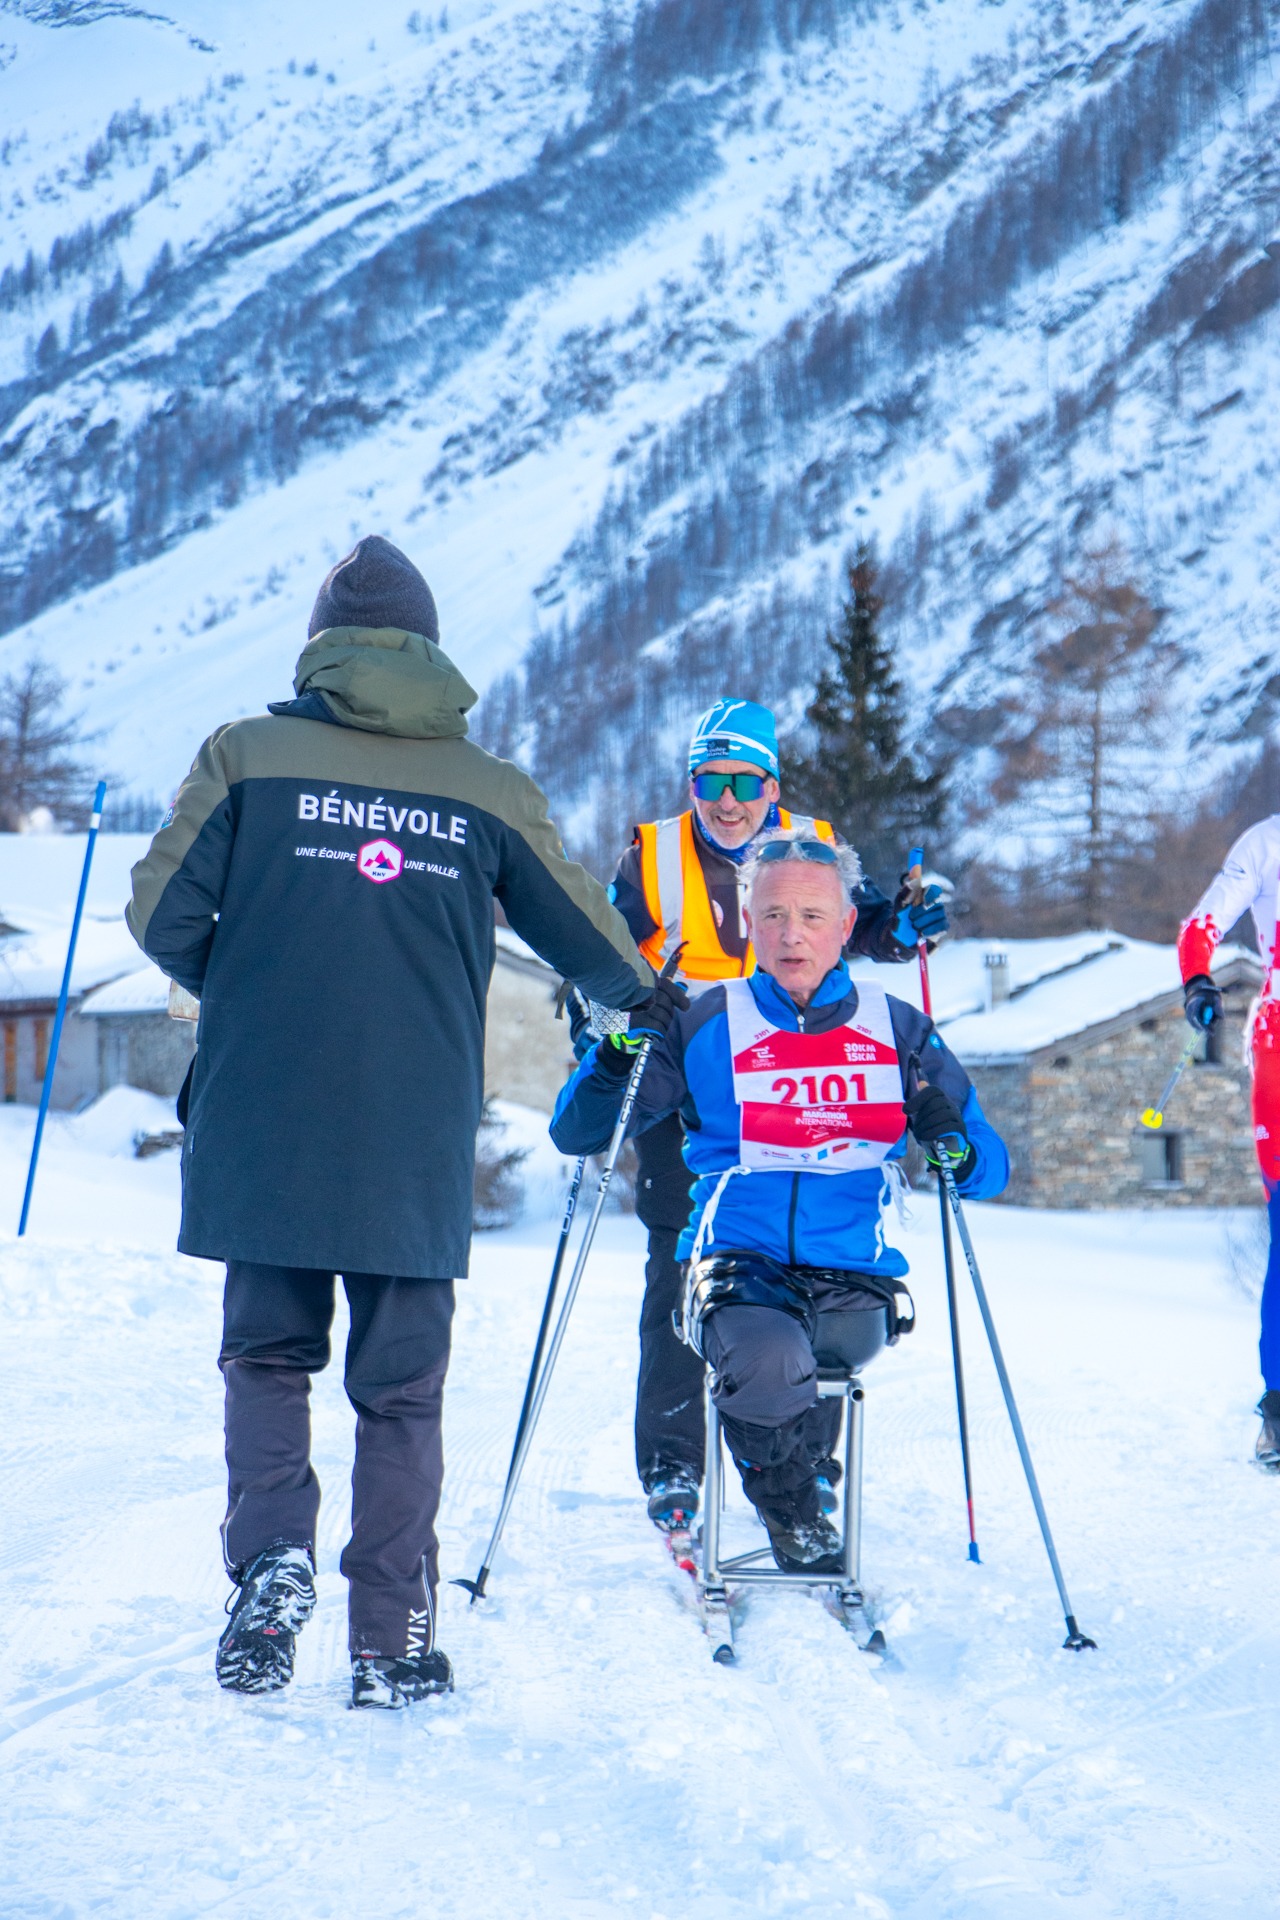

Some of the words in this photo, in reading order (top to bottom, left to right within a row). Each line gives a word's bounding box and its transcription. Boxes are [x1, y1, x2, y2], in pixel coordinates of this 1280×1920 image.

[299, 790, 468, 845] BÉNÉVOLE
[296, 847, 318, 857] UNE
[318, 847, 357, 862] ÉQUIPE
[404, 860, 426, 871] UNE
[427, 863, 460, 879] VALLÉE
[754, 1029, 770, 1041] 2101
[856, 1024, 872, 1035] 2101
[772, 1073, 868, 1105] 2101
[802, 1110, 848, 1121] MARATHON
[795, 1117, 853, 1129] INTERNATIONAL
